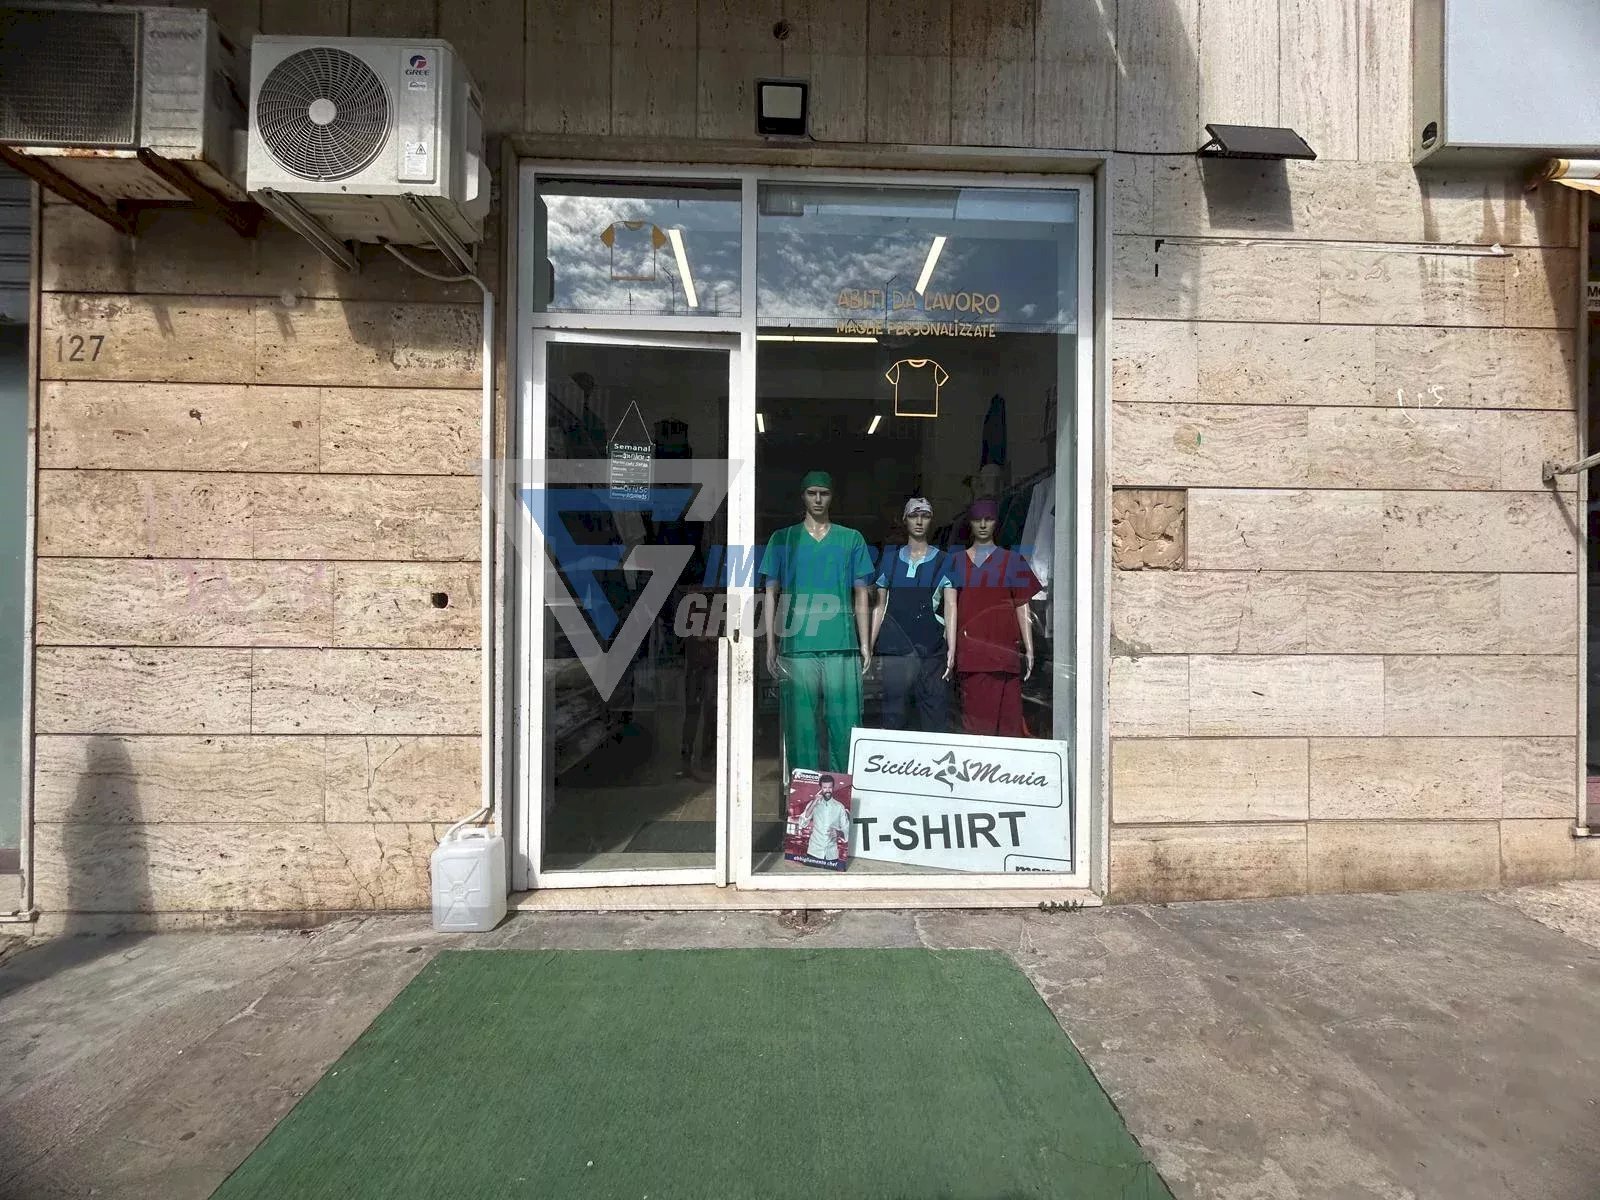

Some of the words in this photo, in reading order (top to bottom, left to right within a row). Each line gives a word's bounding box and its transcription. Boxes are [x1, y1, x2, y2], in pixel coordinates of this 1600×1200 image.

[837, 288, 885, 310] ABITI
[892, 290, 916, 310] DA
[924, 292, 1000, 314] LAVORO
[836, 320, 883, 336] MAGLIE
[56, 334, 104, 362] 127
[614, 443, 651, 452] Semanal
[863, 754, 933, 778] Sicilia
[968, 761, 1049, 788] Mania
[852, 811, 1026, 852] T-SHIRT
